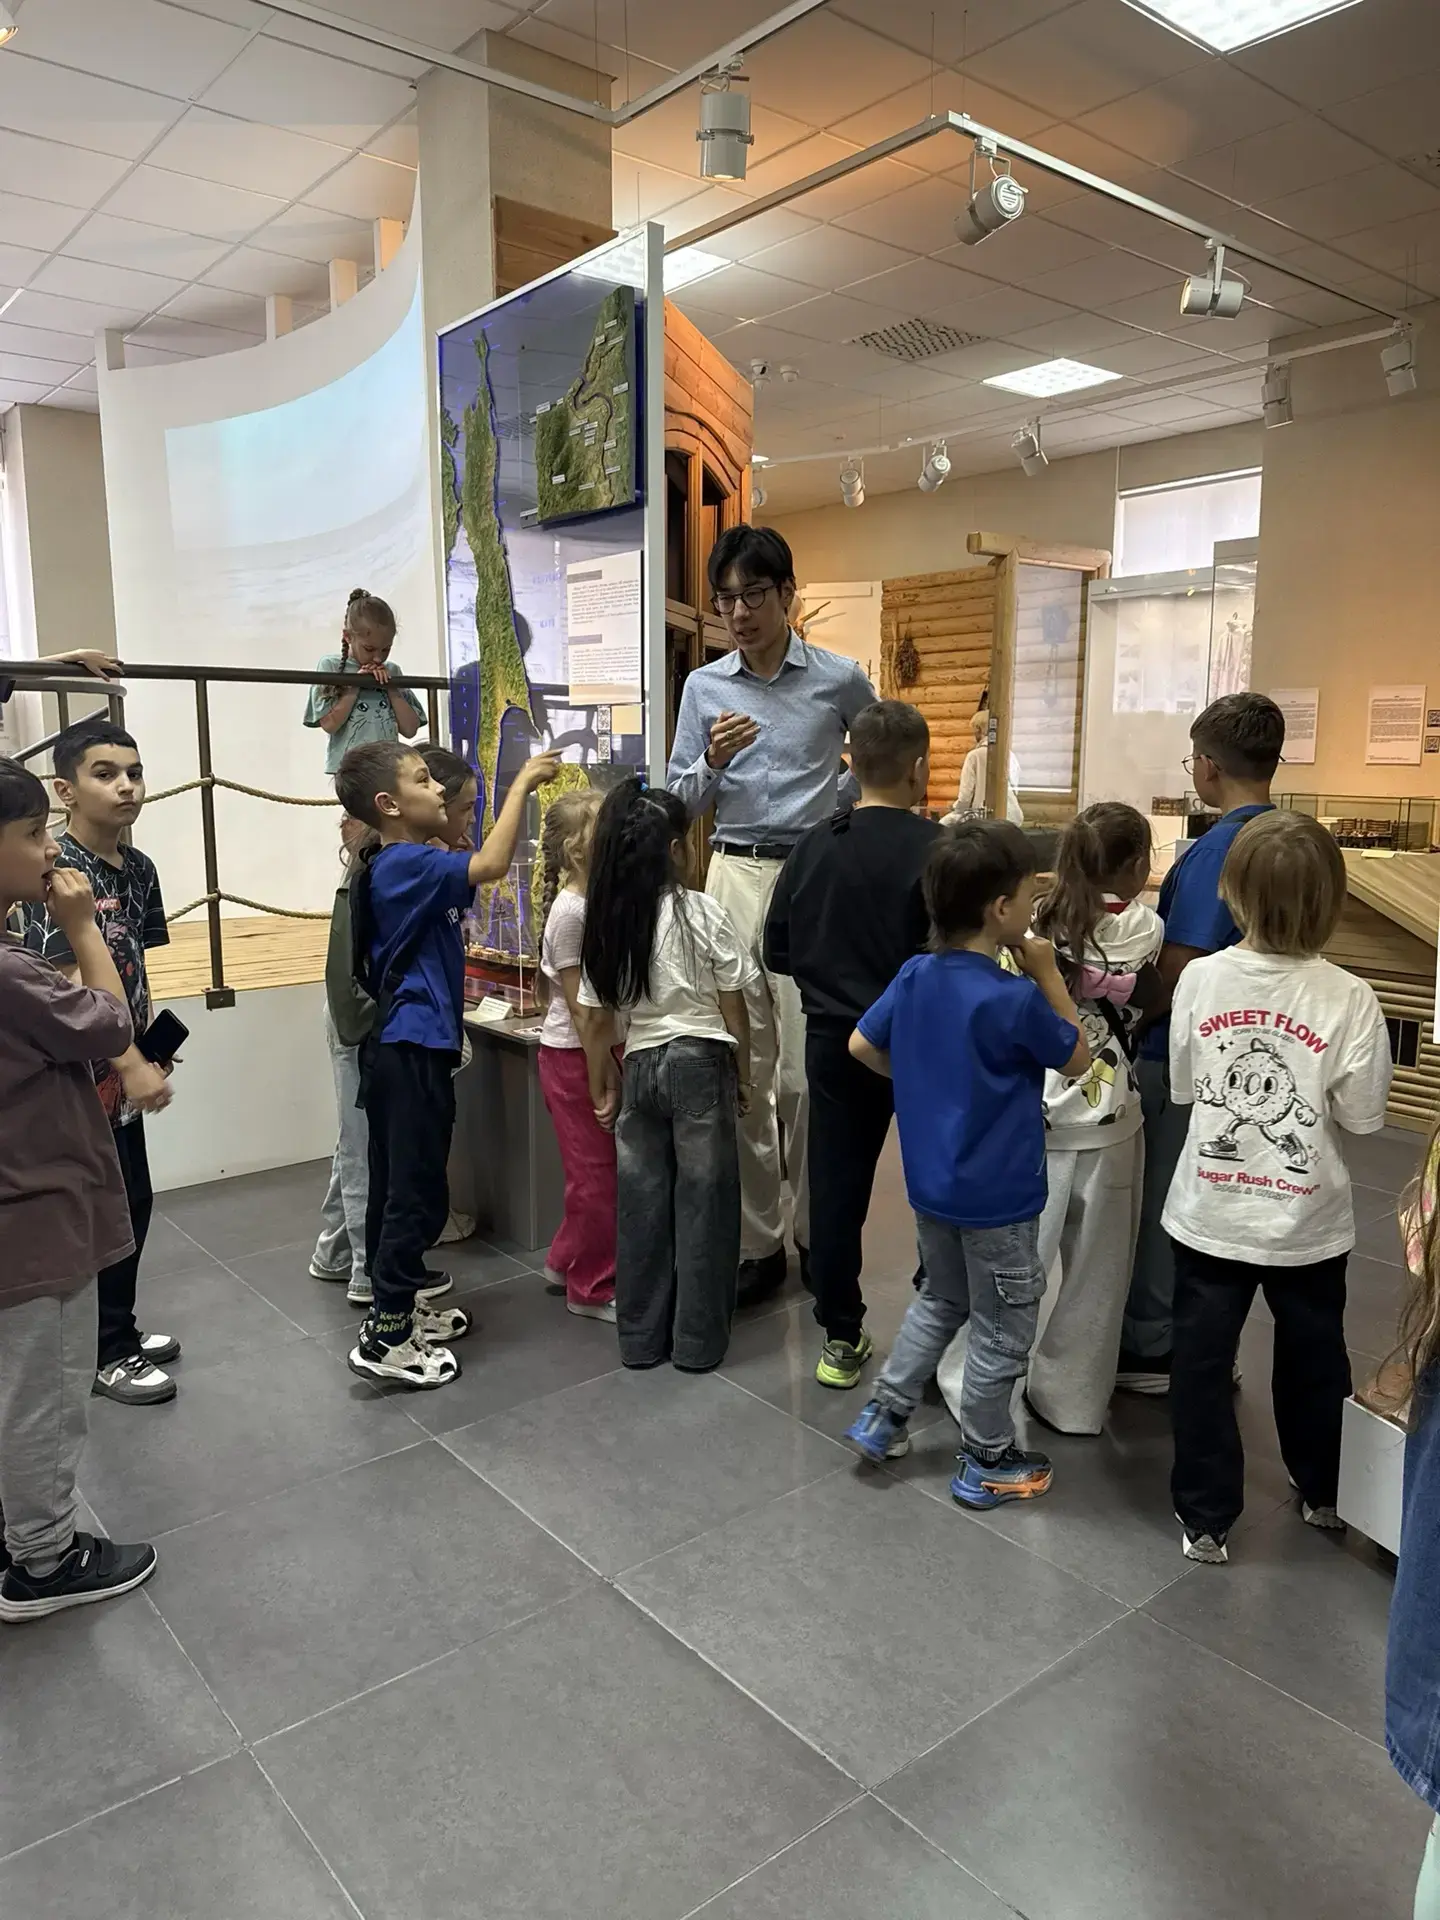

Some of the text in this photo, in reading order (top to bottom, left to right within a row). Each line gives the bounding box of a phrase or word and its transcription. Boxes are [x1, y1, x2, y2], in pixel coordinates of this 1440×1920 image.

[1198, 1009, 1329, 1054] SWEET FLOW
[1237, 1172, 1273, 1188] Rush
